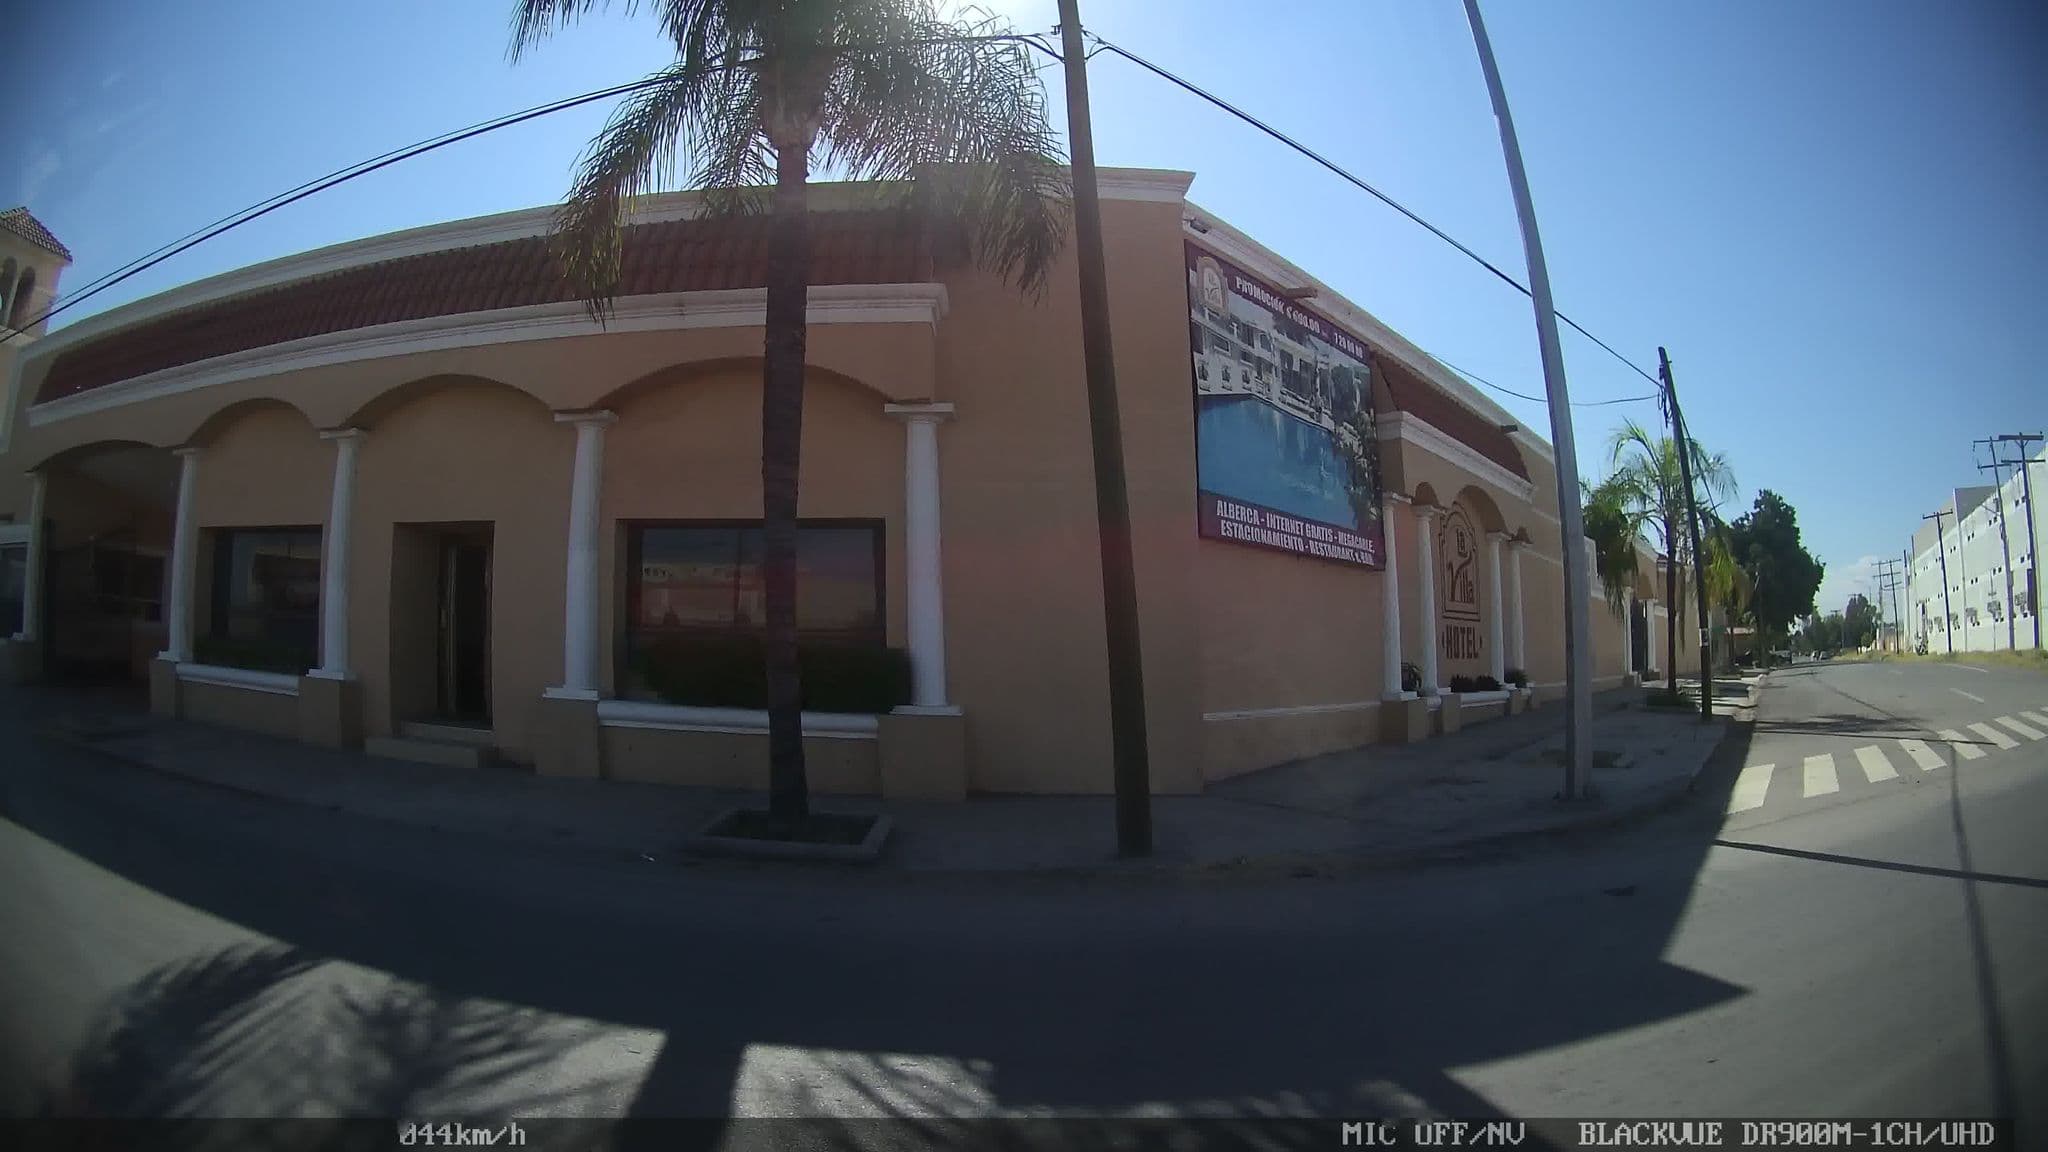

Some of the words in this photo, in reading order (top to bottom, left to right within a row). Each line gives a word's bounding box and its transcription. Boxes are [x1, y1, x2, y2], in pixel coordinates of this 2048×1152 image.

[1216, 500, 1260, 526] ALBERCA
[1266, 512, 1304, 537] INTERNET
[1305, 523, 1333, 543] GRATIS
[1220, 520, 1304, 551] ESTACIONAMIENTO
[1448, 552, 1475, 604] Villa
[1446, 624, 1479, 660] HOTEL
